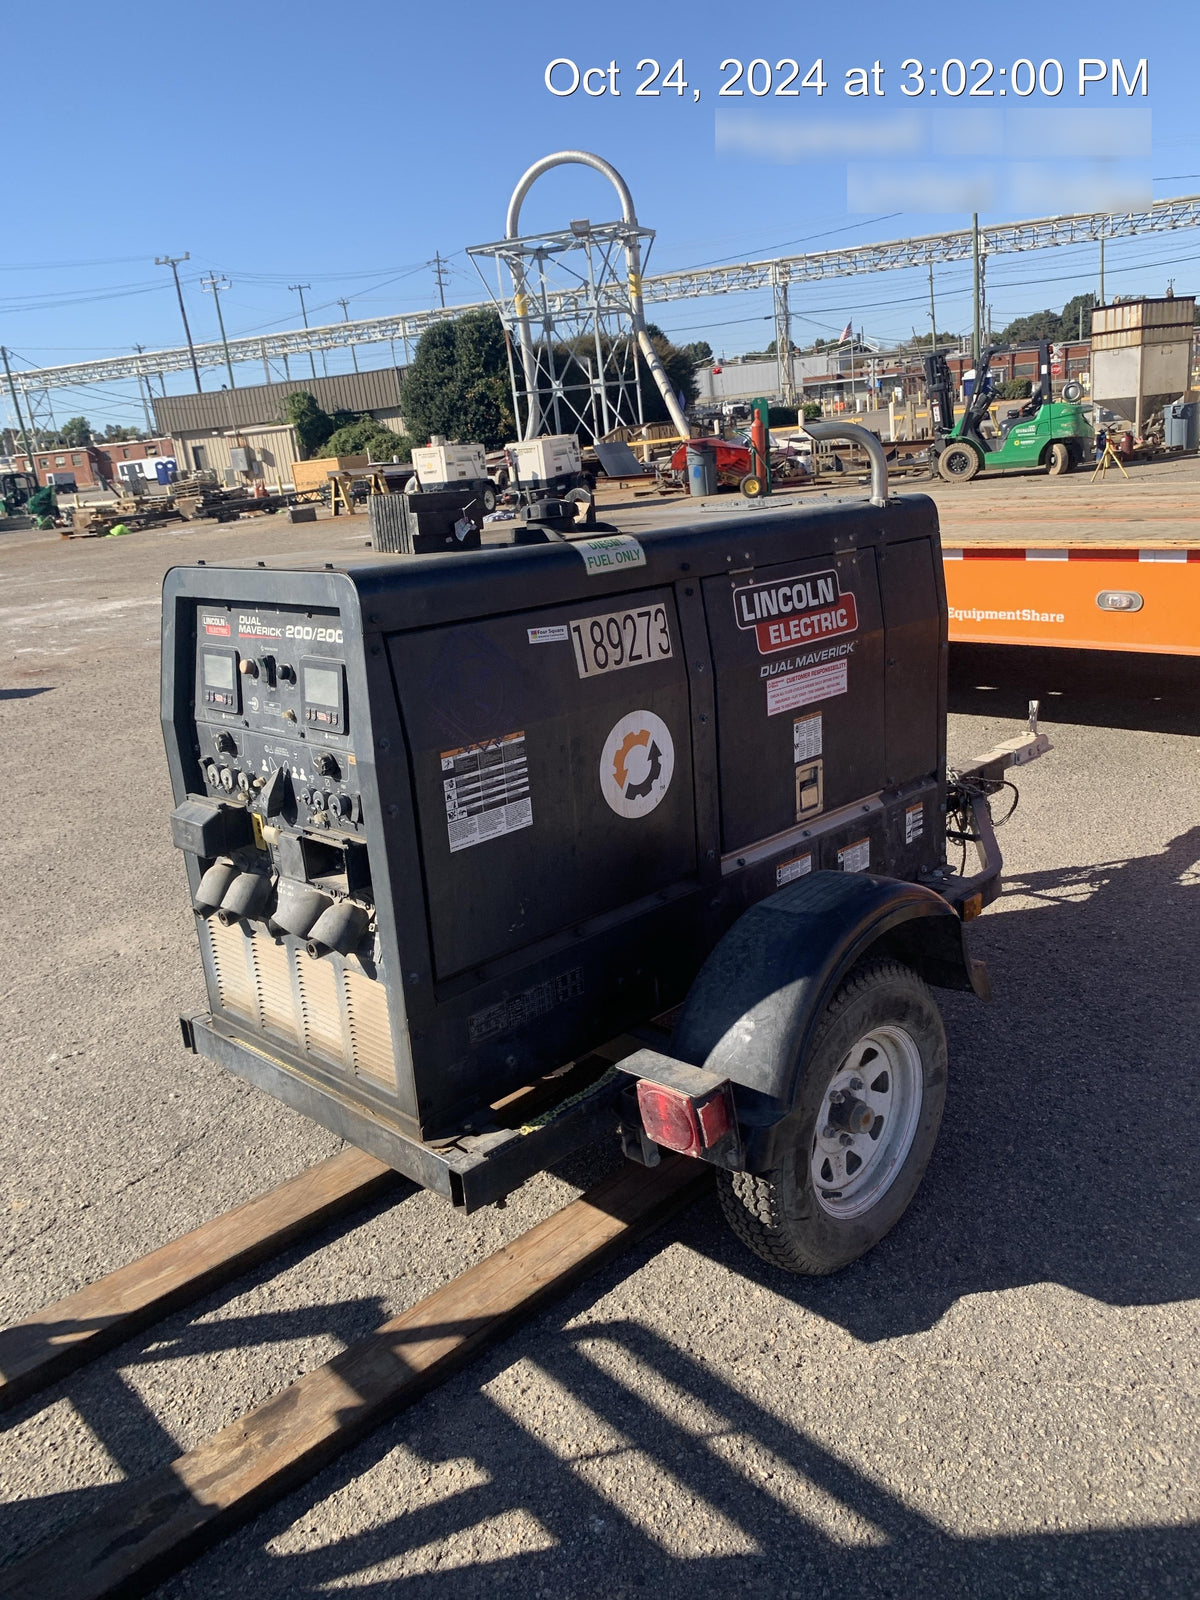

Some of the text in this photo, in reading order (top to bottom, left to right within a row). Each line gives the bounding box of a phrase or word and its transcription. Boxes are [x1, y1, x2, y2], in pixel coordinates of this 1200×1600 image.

[587, 549, 640, 568] FUEL ONLY
[741, 578, 835, 621] LINCOLN
[203, 616, 225, 626] LINCOLN
[239, 615, 261, 625] DUAL
[948, 607, 1065, 623] EquipmentShare
[239, 625, 282, 636] MAVERICK
[769, 608, 848, 645] ELECTRIC
[572, 607, 671, 673] 189273
[760, 641, 855, 678] DUAL MAVERICK
